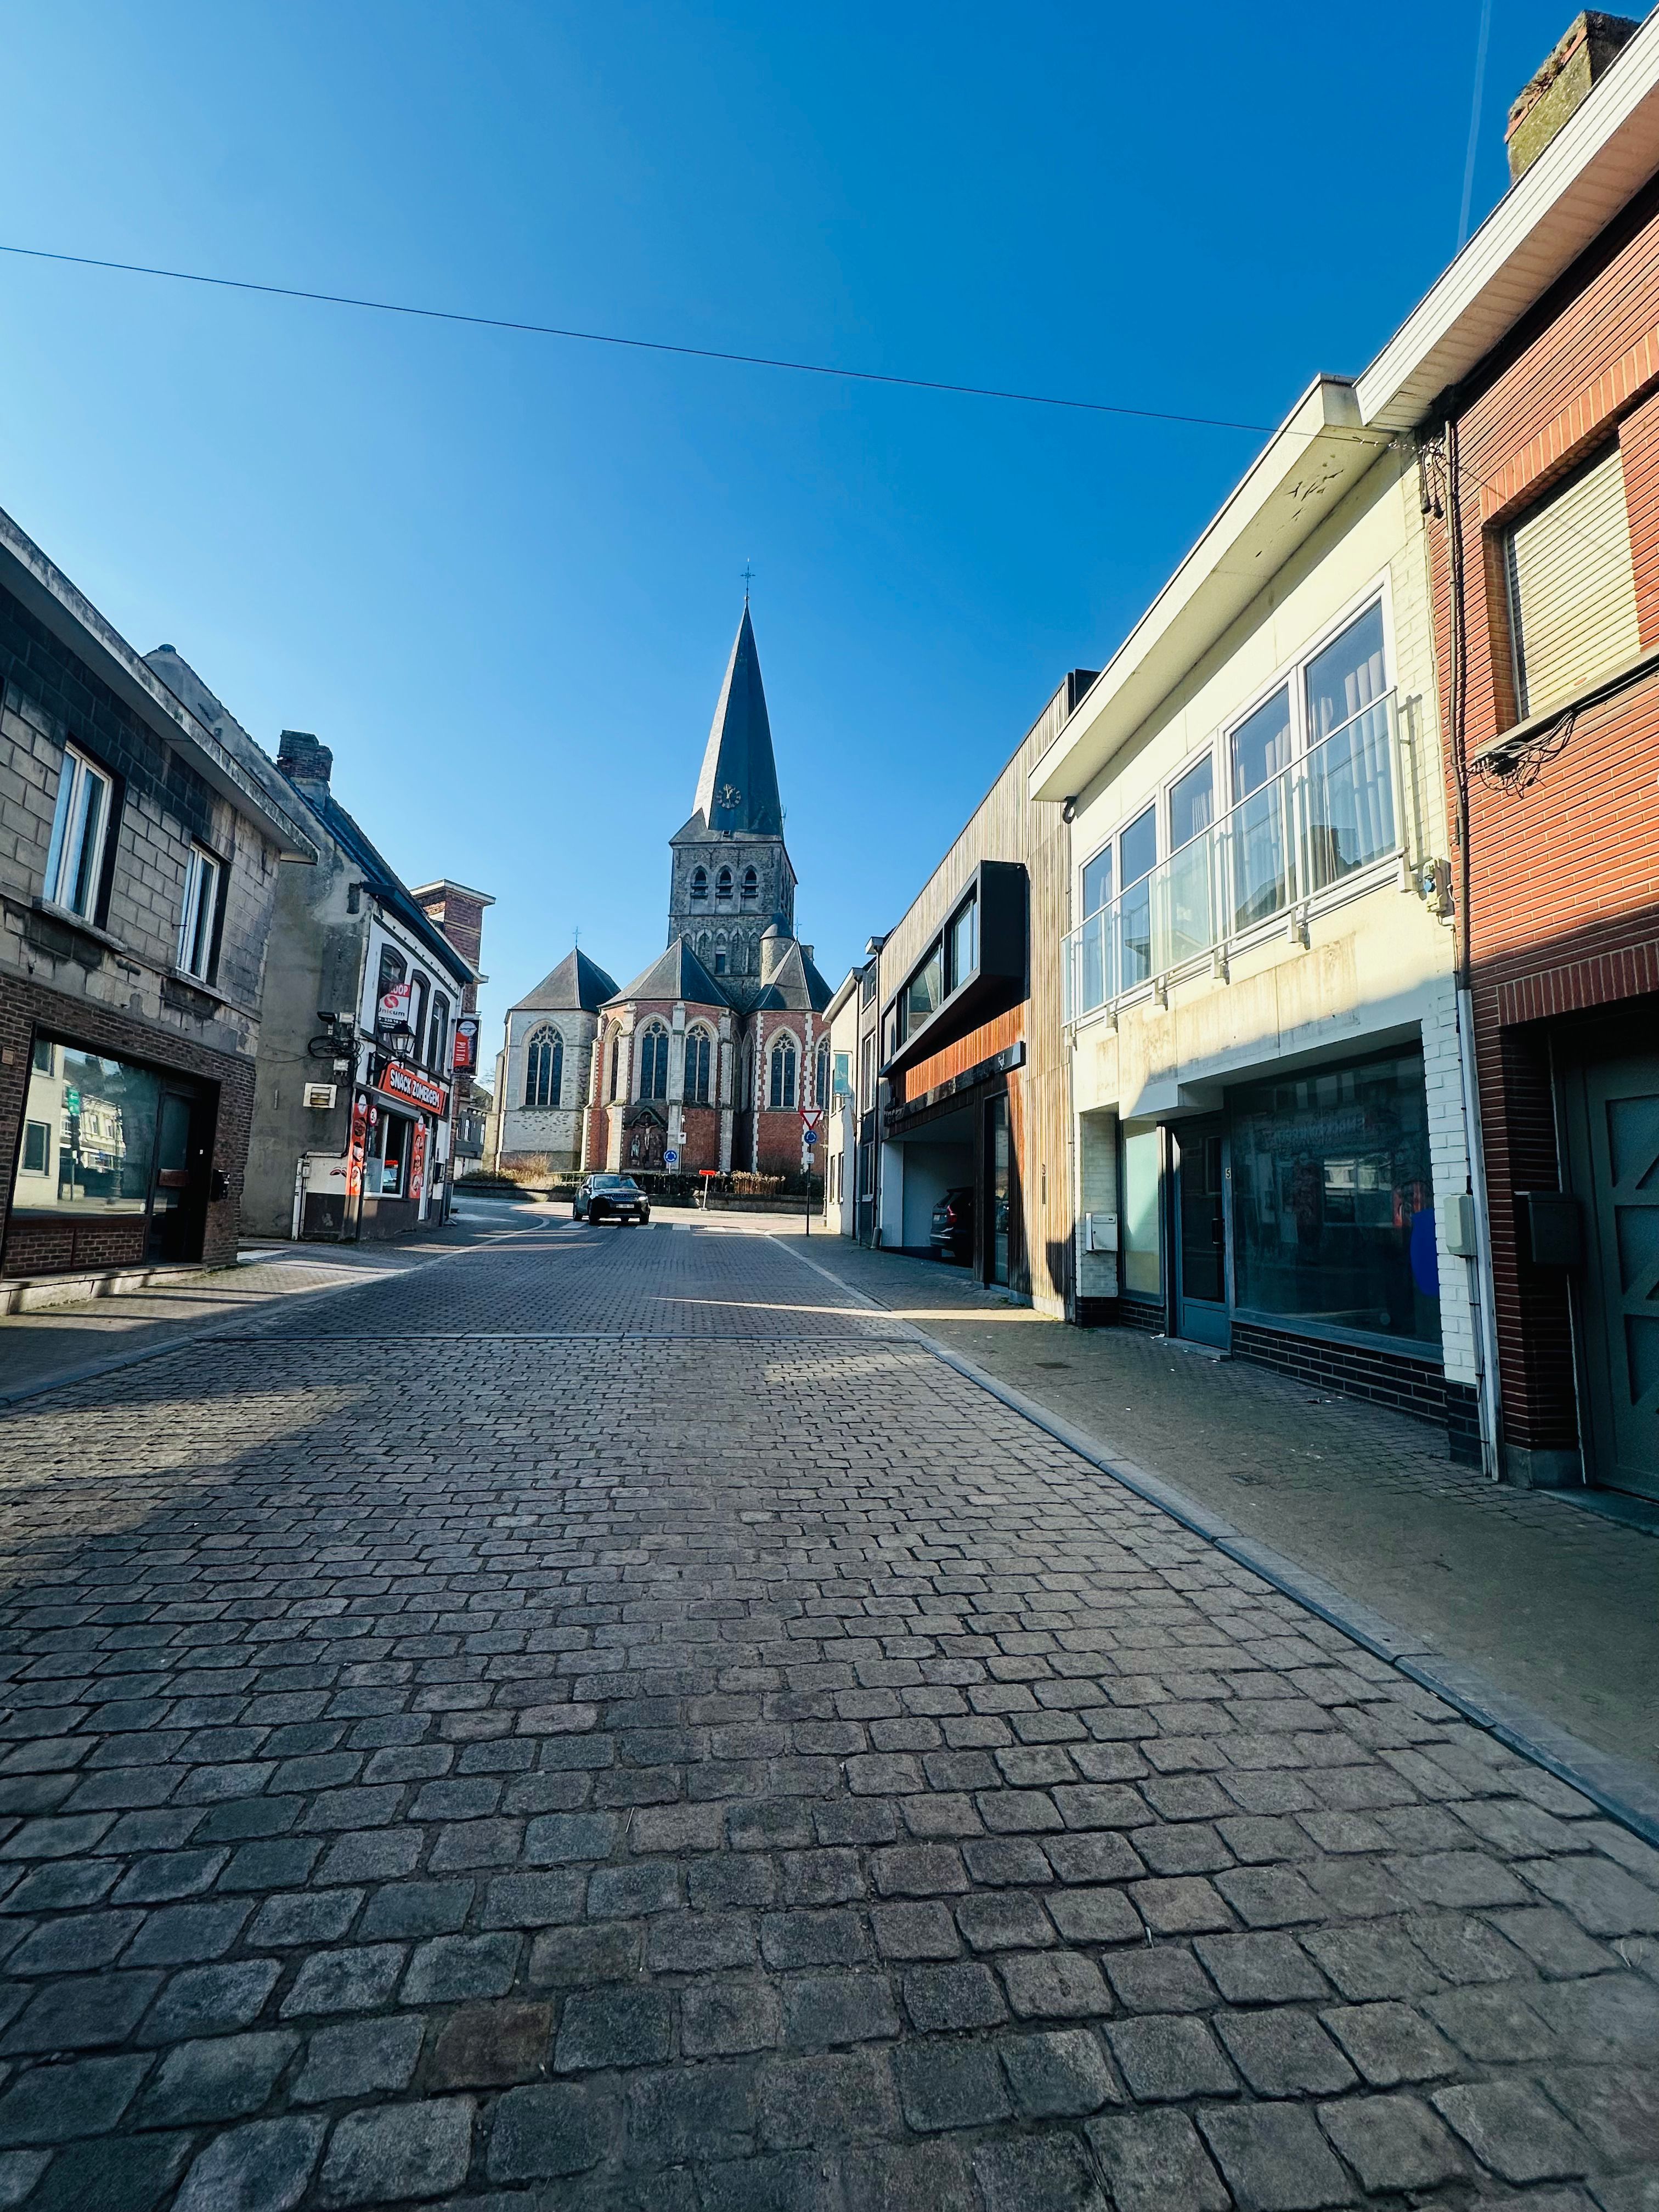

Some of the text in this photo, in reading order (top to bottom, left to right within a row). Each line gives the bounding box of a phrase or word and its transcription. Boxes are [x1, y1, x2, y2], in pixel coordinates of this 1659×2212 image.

[455, 1042, 466, 1062] PITTA
[390, 1069, 439, 1108] SNACK ZOMERGEM
[1226, 1169, 1230, 1178] 5
